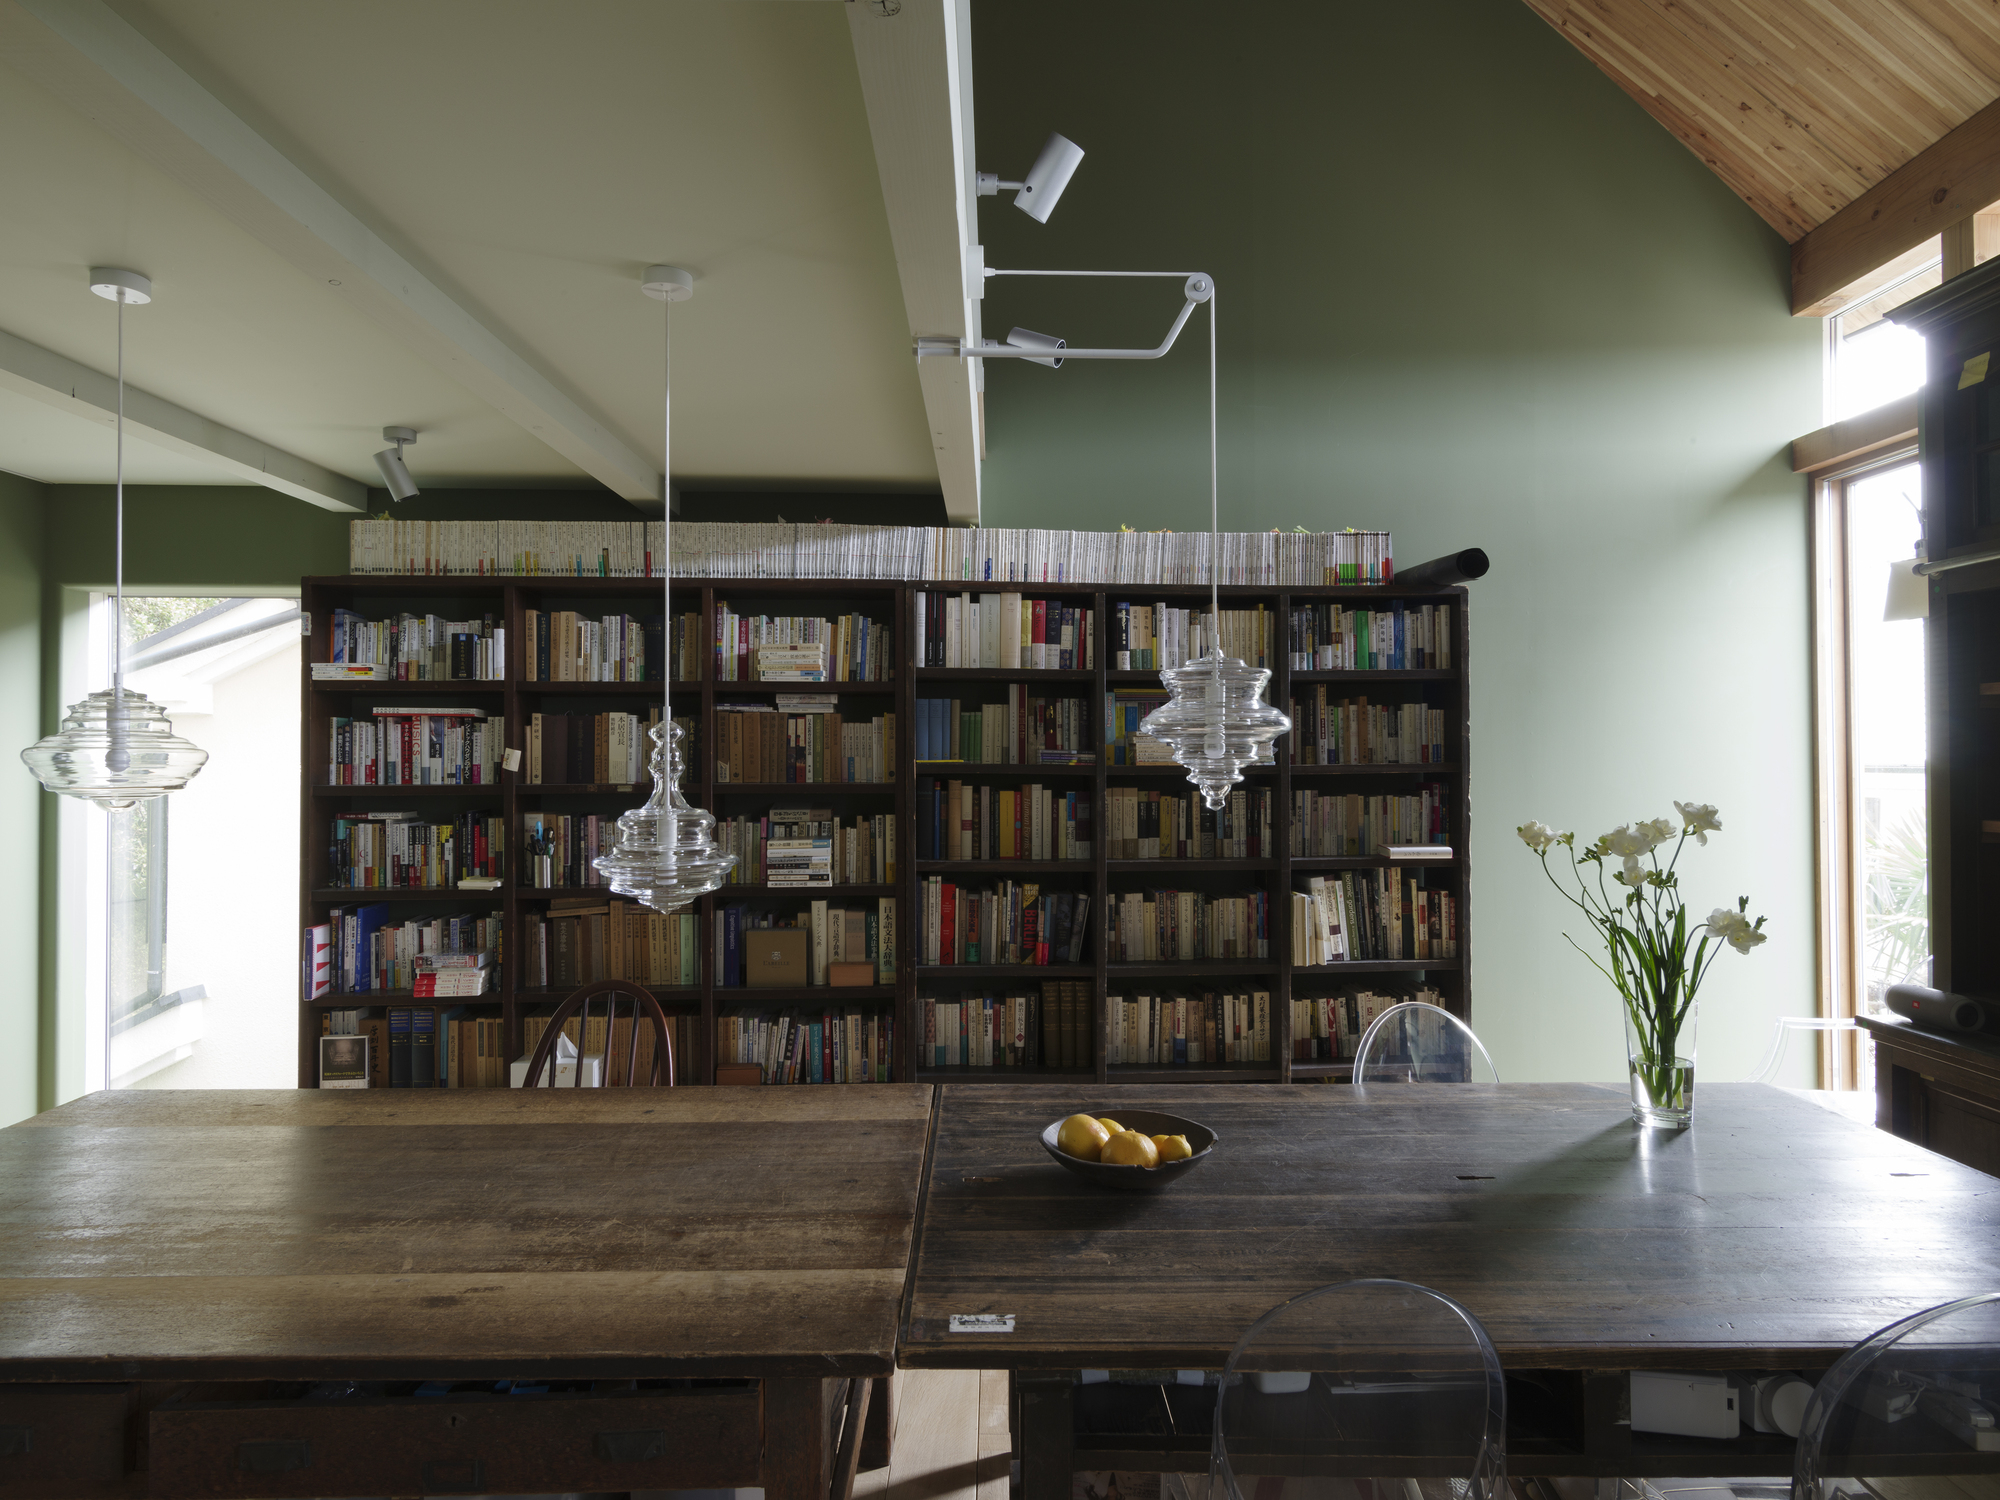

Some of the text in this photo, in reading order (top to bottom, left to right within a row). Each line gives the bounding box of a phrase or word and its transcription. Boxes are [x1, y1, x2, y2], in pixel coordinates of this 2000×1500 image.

[1023, 909, 1037, 949] BERLIN
[1346, 900, 1355, 925] gardens
[883, 906, 892, 967] 日本語文法大辞典
